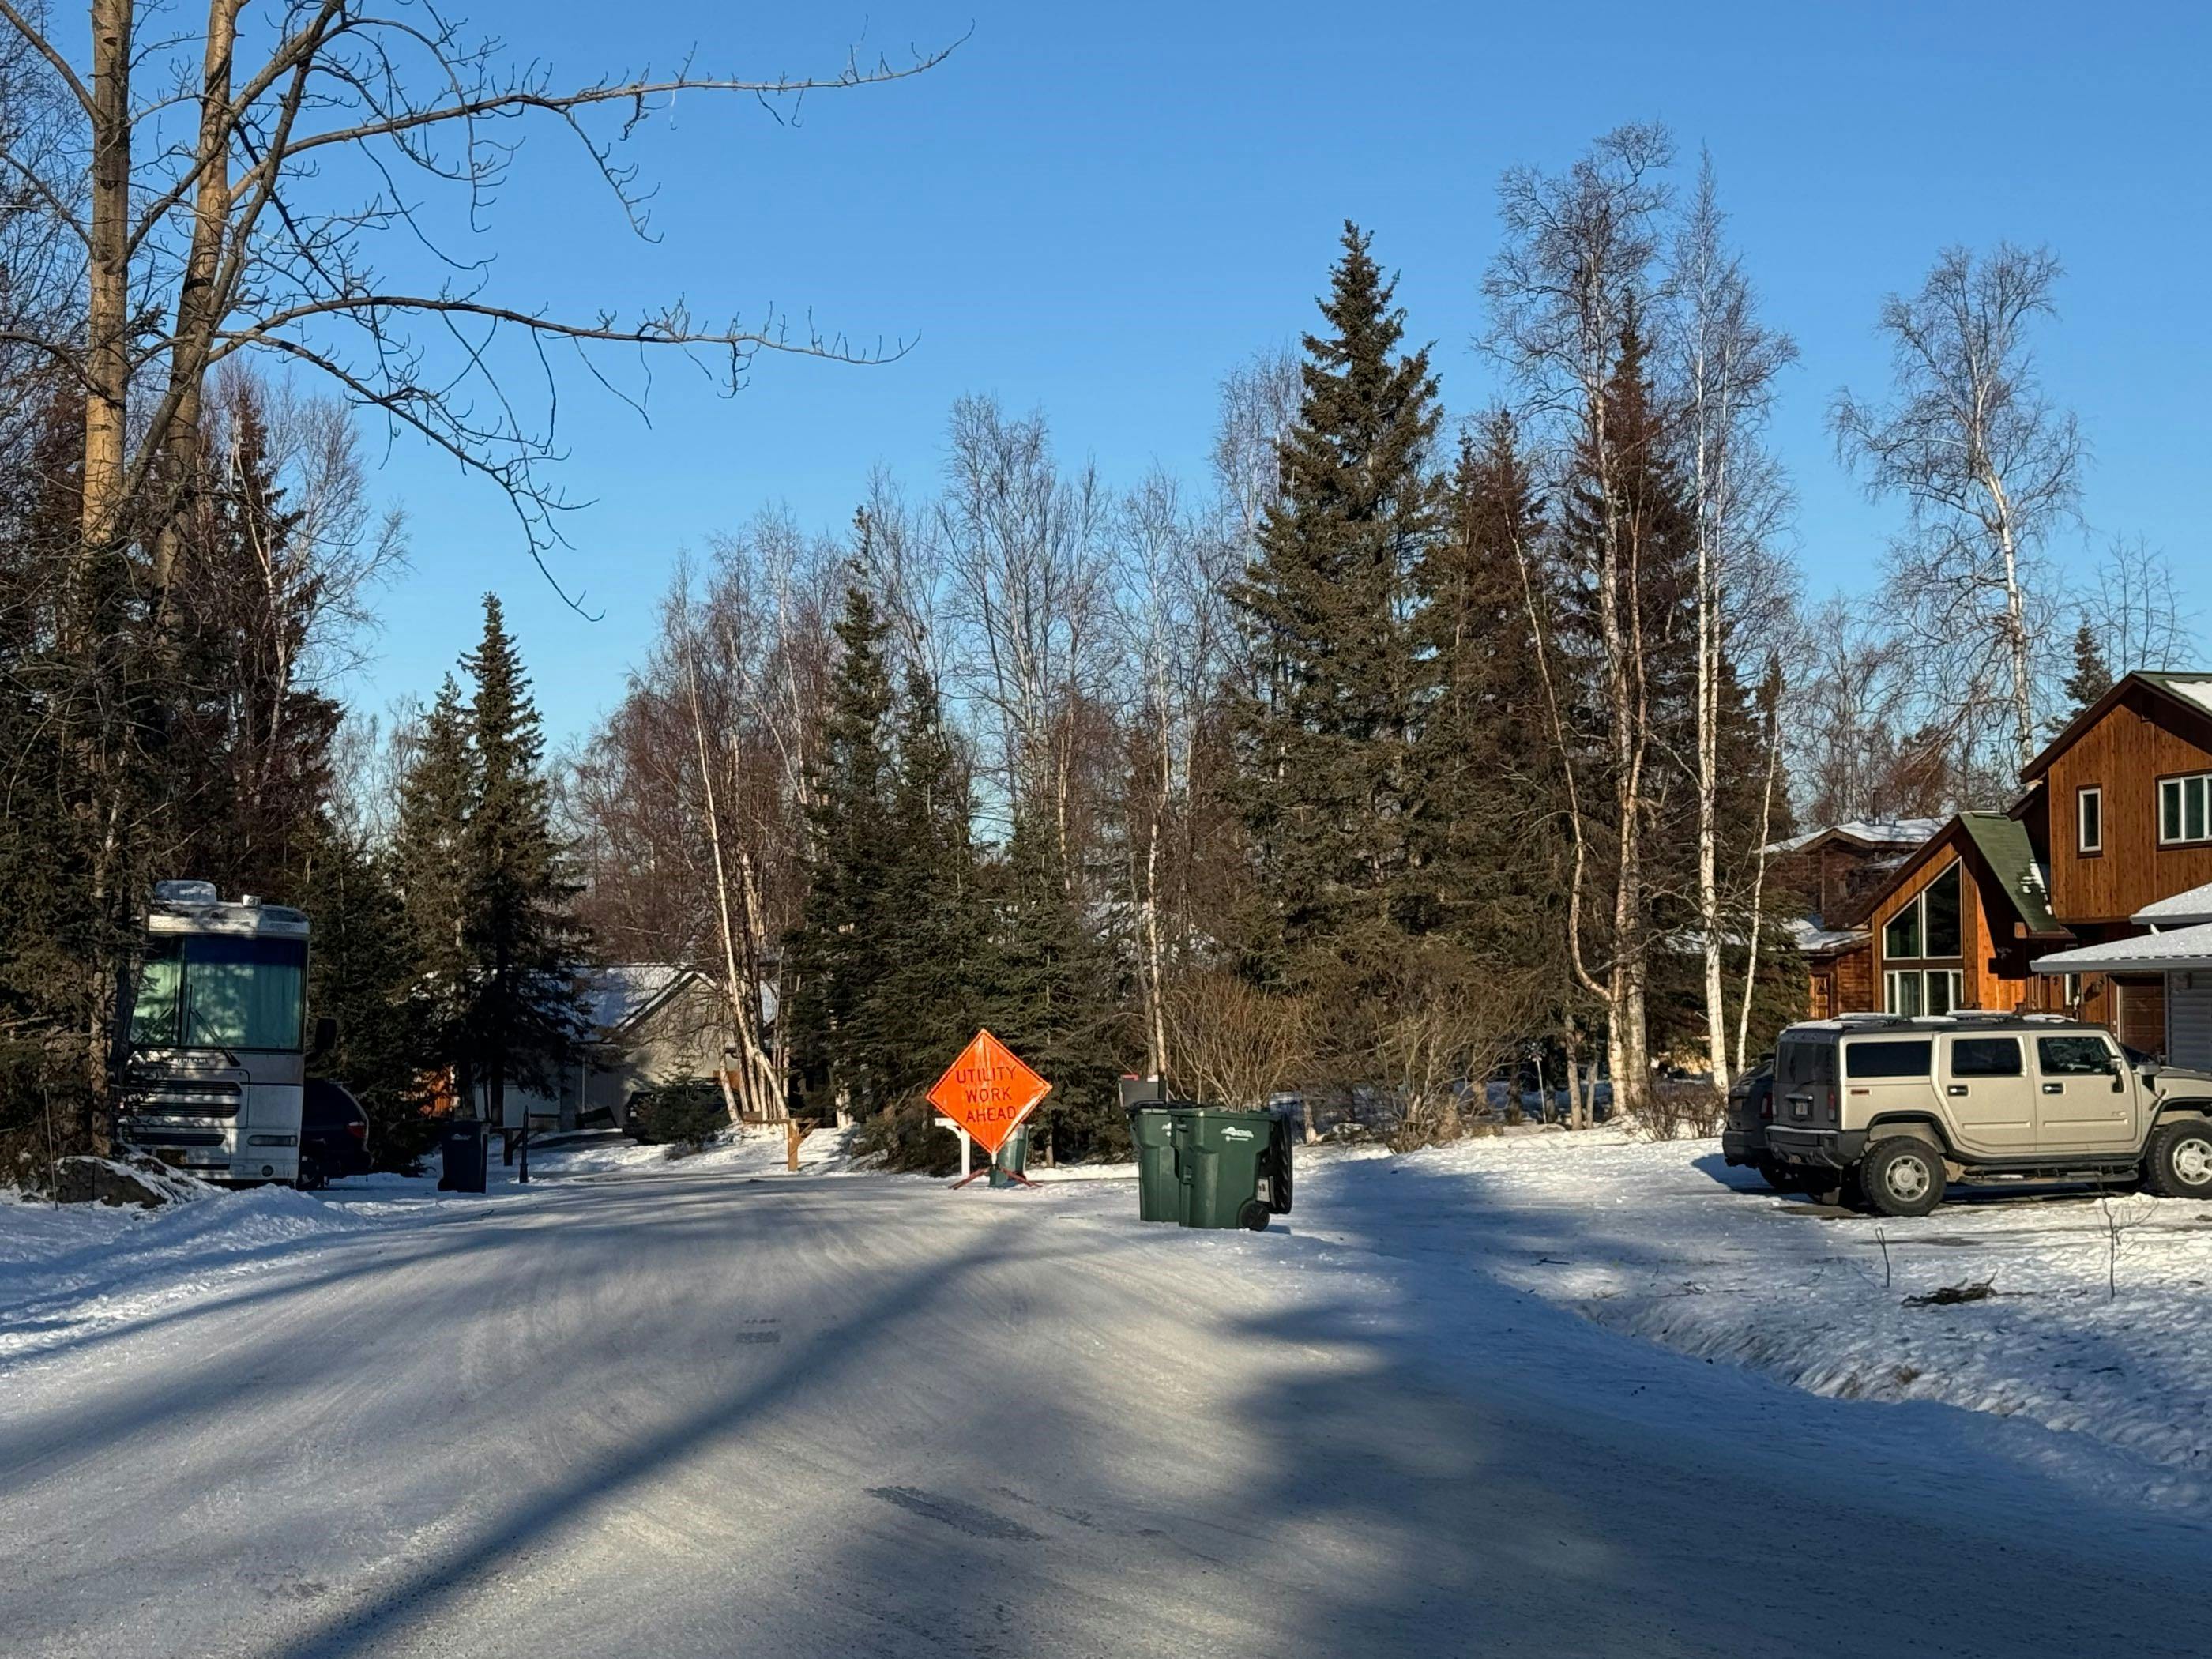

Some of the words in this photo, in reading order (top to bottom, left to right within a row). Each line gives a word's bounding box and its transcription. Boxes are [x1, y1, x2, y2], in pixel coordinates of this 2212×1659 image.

[956, 1066, 1017, 1084] UTILITY
[965, 1086, 1012, 1104] WORK
[966, 1106, 1017, 1123] AHEAD
